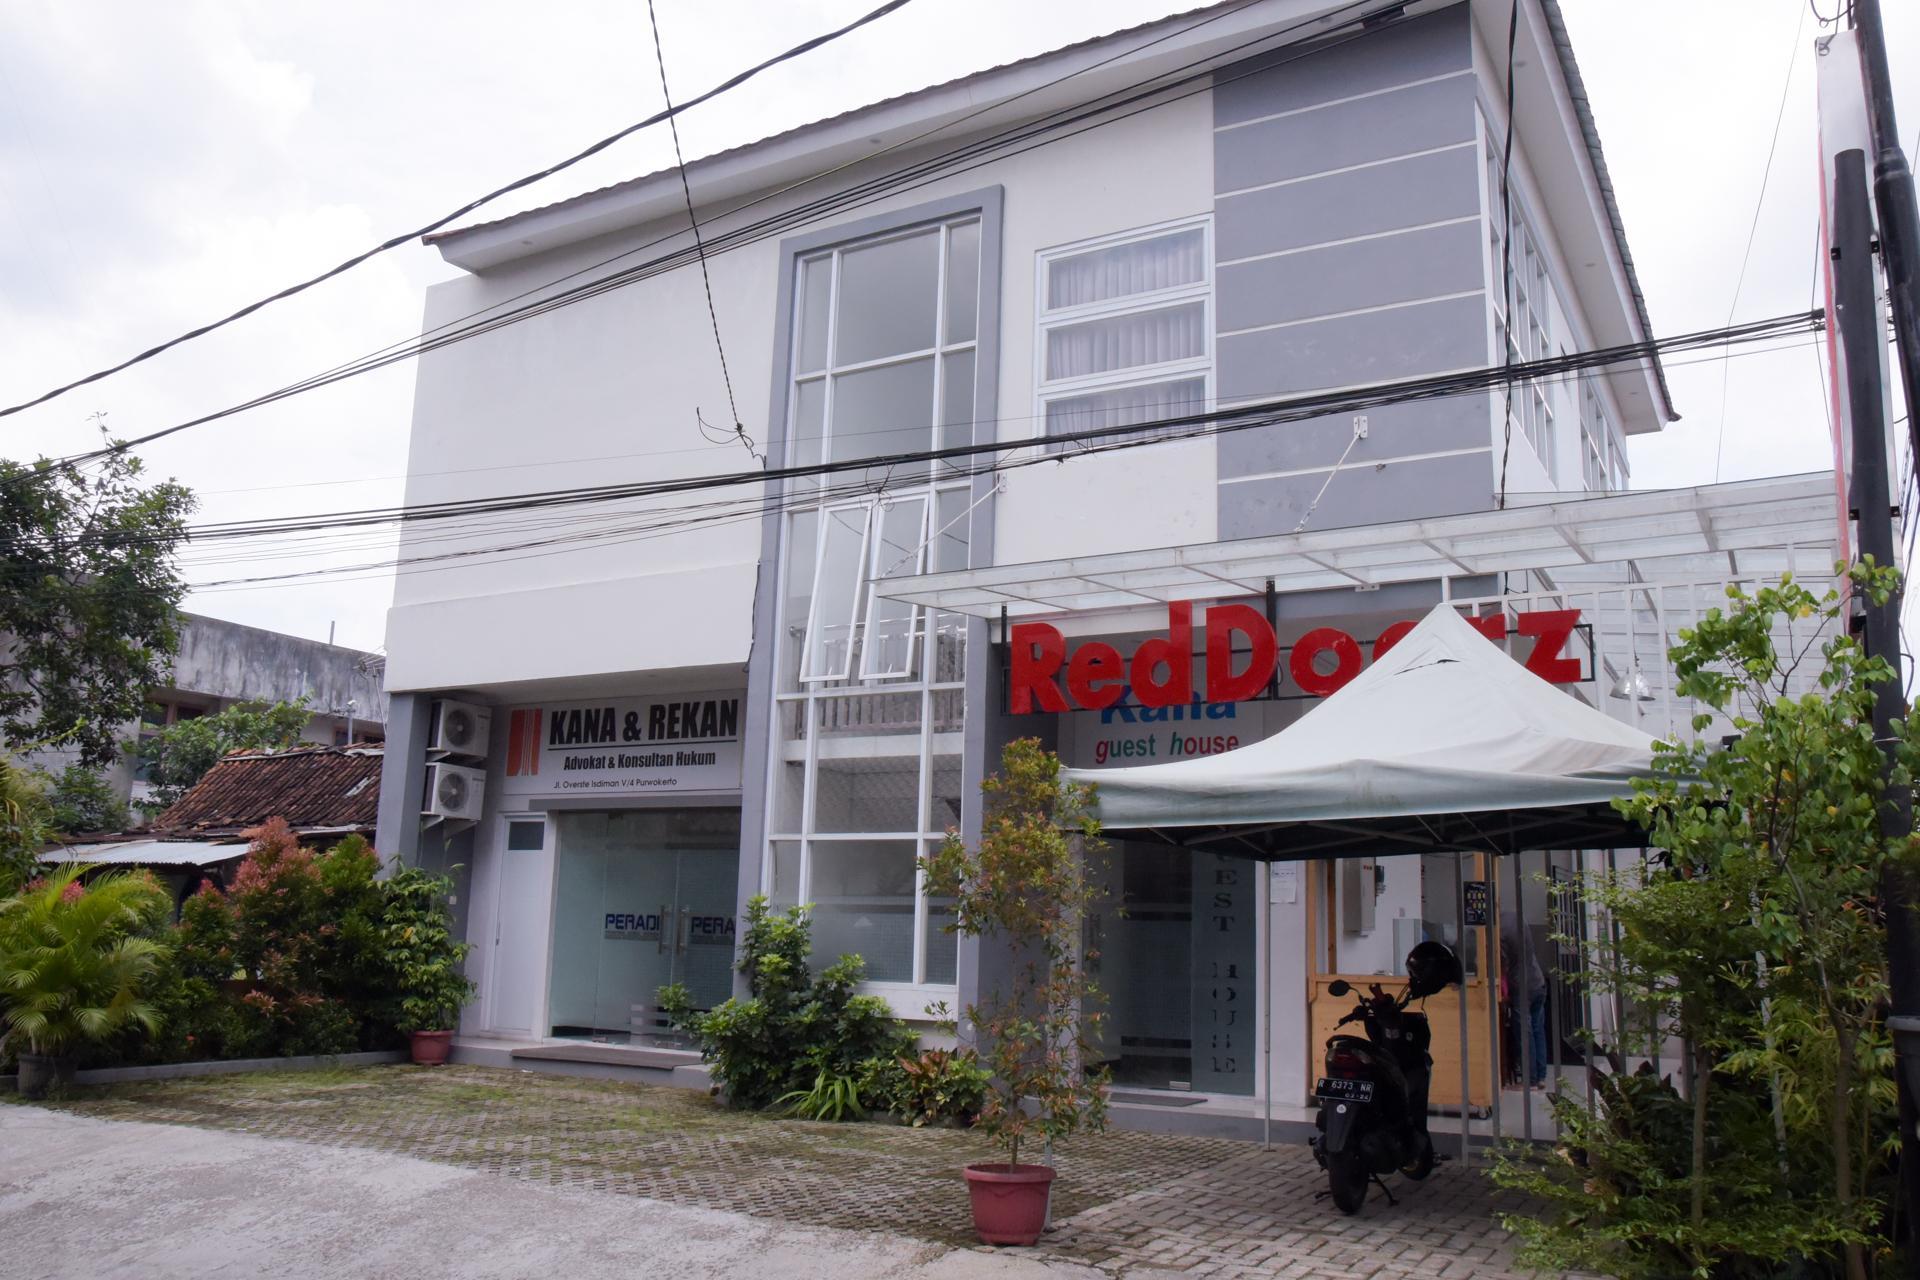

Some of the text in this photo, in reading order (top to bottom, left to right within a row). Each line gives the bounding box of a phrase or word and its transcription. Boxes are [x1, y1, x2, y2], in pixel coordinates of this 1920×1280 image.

[549, 699, 739, 745] KANA & REKAN
[1095, 731, 1239, 764] guest house
[563, 750, 716, 770] Advokat & Konsultan Hukum
[562, 779, 590, 789] Overste
[591, 778, 620, 788] Isdiman
[621, 778, 635, 787] V/4
[635, 776, 678, 787] Purwokerto
[604, 913, 660, 931] PERADI
[1318, 1079, 1325, 1088] R
[1331, 1080, 1354, 1090] 6373
